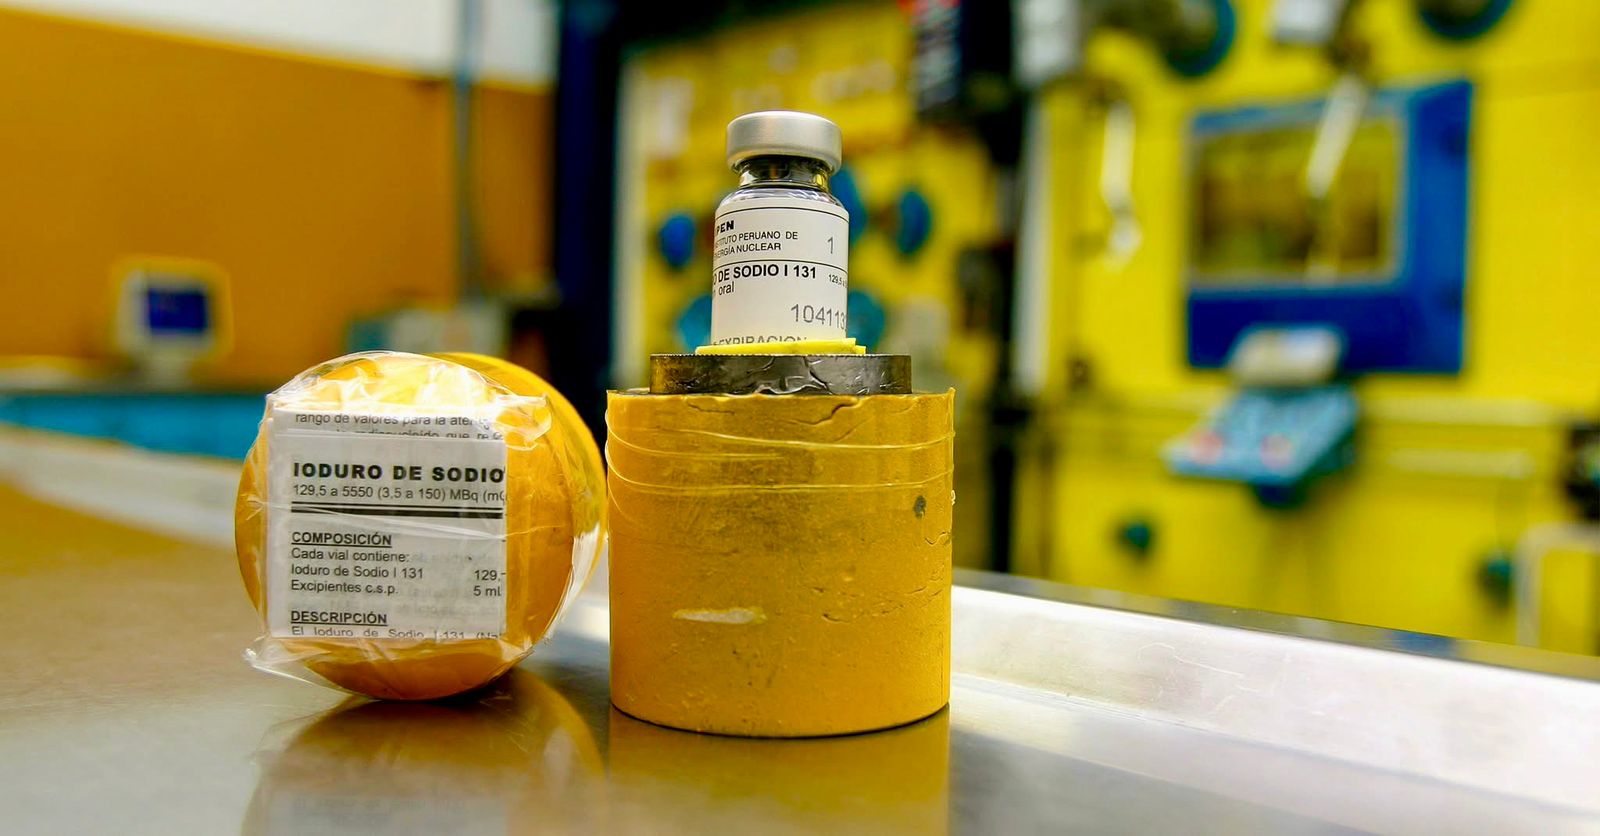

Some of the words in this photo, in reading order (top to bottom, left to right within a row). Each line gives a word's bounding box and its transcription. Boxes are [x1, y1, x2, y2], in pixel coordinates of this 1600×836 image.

[739, 231, 780, 241] PERUANO
[785, 231, 798, 240] DE
[736, 243, 781, 253] NUCLEAR
[827, 236, 834, 254] 1
[718, 268, 730, 283] DE
[733, 264, 779, 279] SODIO
[784, 264, 788, 276] I
[793, 265, 816, 279] 131
[718, 281, 734, 296] oral
[791, 303, 847, 330] 104113
[295, 413, 331, 426] rango
[334, 413, 350, 423] de
[353, 413, 399, 425] valores
[293, 462, 383, 480] IODURO
[393, 465, 422, 480] DE
[431, 466, 504, 483] SODIO
[293, 484, 328, 497] 129,5
[330, 488, 339, 497] a
[342, 486, 374, 498] 5550
[377, 487, 402, 500] (3,5
[405, 490, 414, 499] a
[418, 489, 446, 502] 150)
[449, 490, 479, 503] MBq
[291, 531, 392, 546] COMPOSICIÓN
[291, 547, 324, 560] Cada
[327, 549, 349, 560] vial
[352, 551, 410, 563] contiene:
[291, 564, 330, 576] Ioduro
[333, 566, 350, 576] de
[353, 566, 390, 578] Sodio
[401, 568, 424, 579] 131
[290, 580, 362, 594] Excipientes
[364, 585, 400, 597] c.s.p.
[472, 585, 482, 597] 5
[290, 610, 388, 625] DESCRIPCIÓN
[291, 626, 304, 636] El
[362, 628, 379, 638] de
